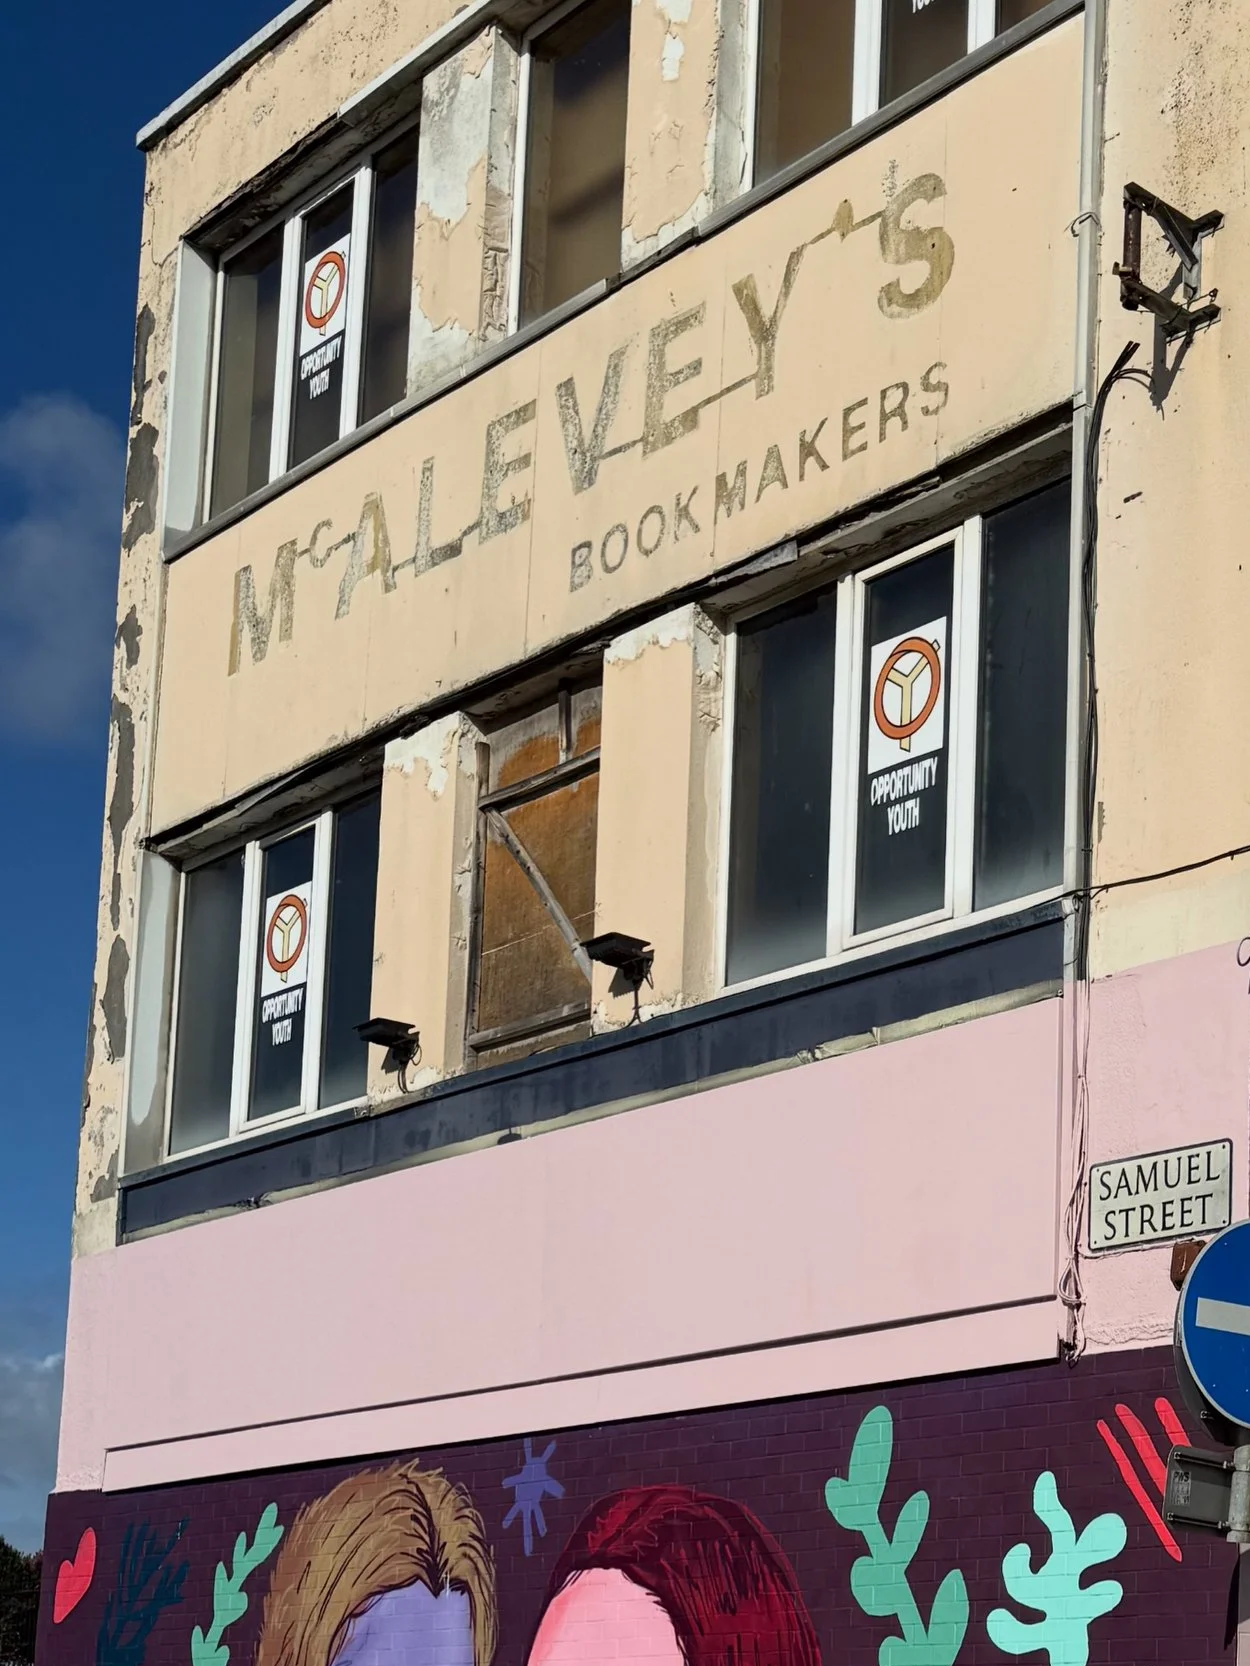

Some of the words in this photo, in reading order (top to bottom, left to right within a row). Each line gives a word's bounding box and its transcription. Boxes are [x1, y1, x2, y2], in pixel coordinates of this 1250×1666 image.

[301, 335, 342, 380] OPPORTUNITY
[310, 368, 330, 400] YOUTH
[569, 362, 950, 593] BOOKMAKERS
[871, 756, 938, 806] OPPORTUNITY
[887, 797, 920, 835] YOUTH
[262, 988, 304, 1023] OPPORTUNITY
[272, 1018, 292, 1046] YOUTH
[1099, 1150, 1221, 1201] SAMUEL
[1103, 1193, 1214, 1241] STREET
